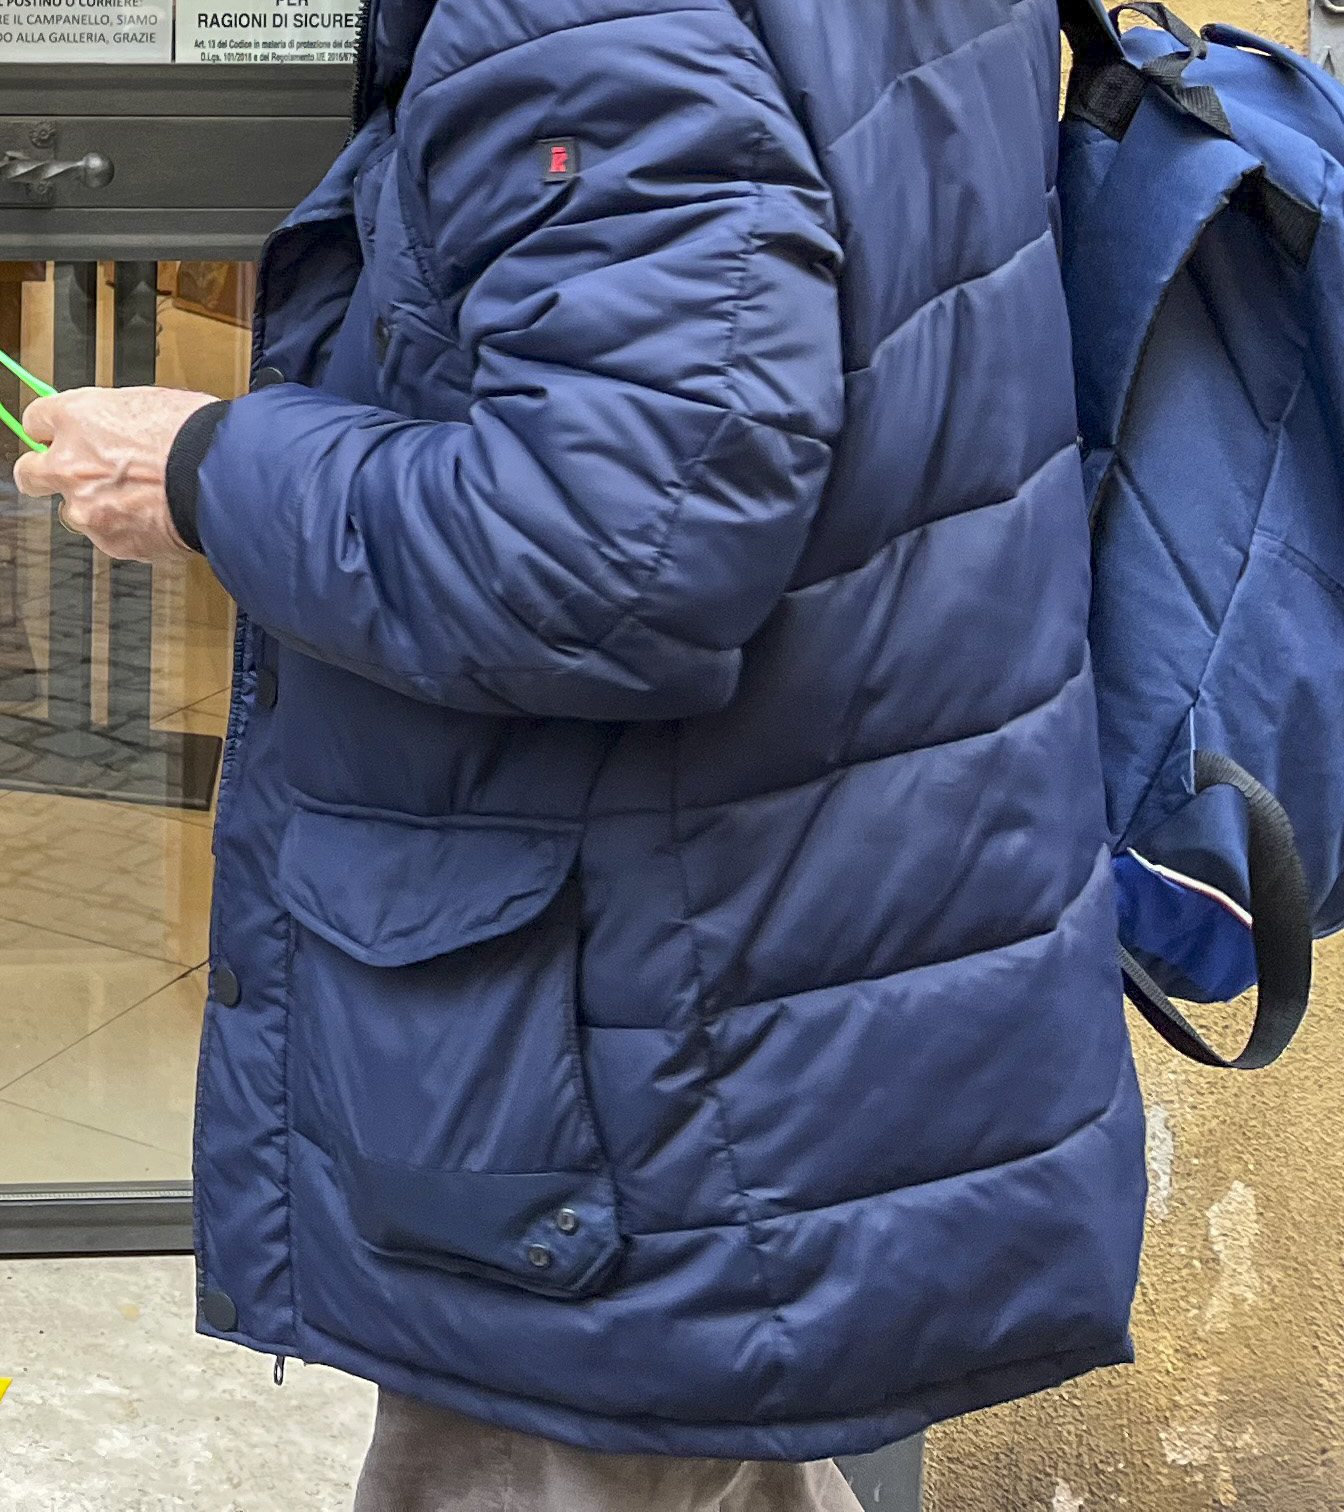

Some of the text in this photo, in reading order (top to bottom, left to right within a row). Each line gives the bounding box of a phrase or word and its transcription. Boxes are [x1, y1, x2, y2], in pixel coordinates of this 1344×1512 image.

[13, 14, 24, 25] IL
[26, 14, 113, 27] CAMPANELLO,
[116, 14, 158, 25] SIAMO
[197, 13, 363, 28] RAGIONI DI SICUREZ
[16, 32, 46, 43] ALLA
[48, 32, 110, 45] GALLERIA,
[112, 32, 156, 44] GRAZIE
[217, 39, 227, 49] del
[288, 39, 294, 49] di
